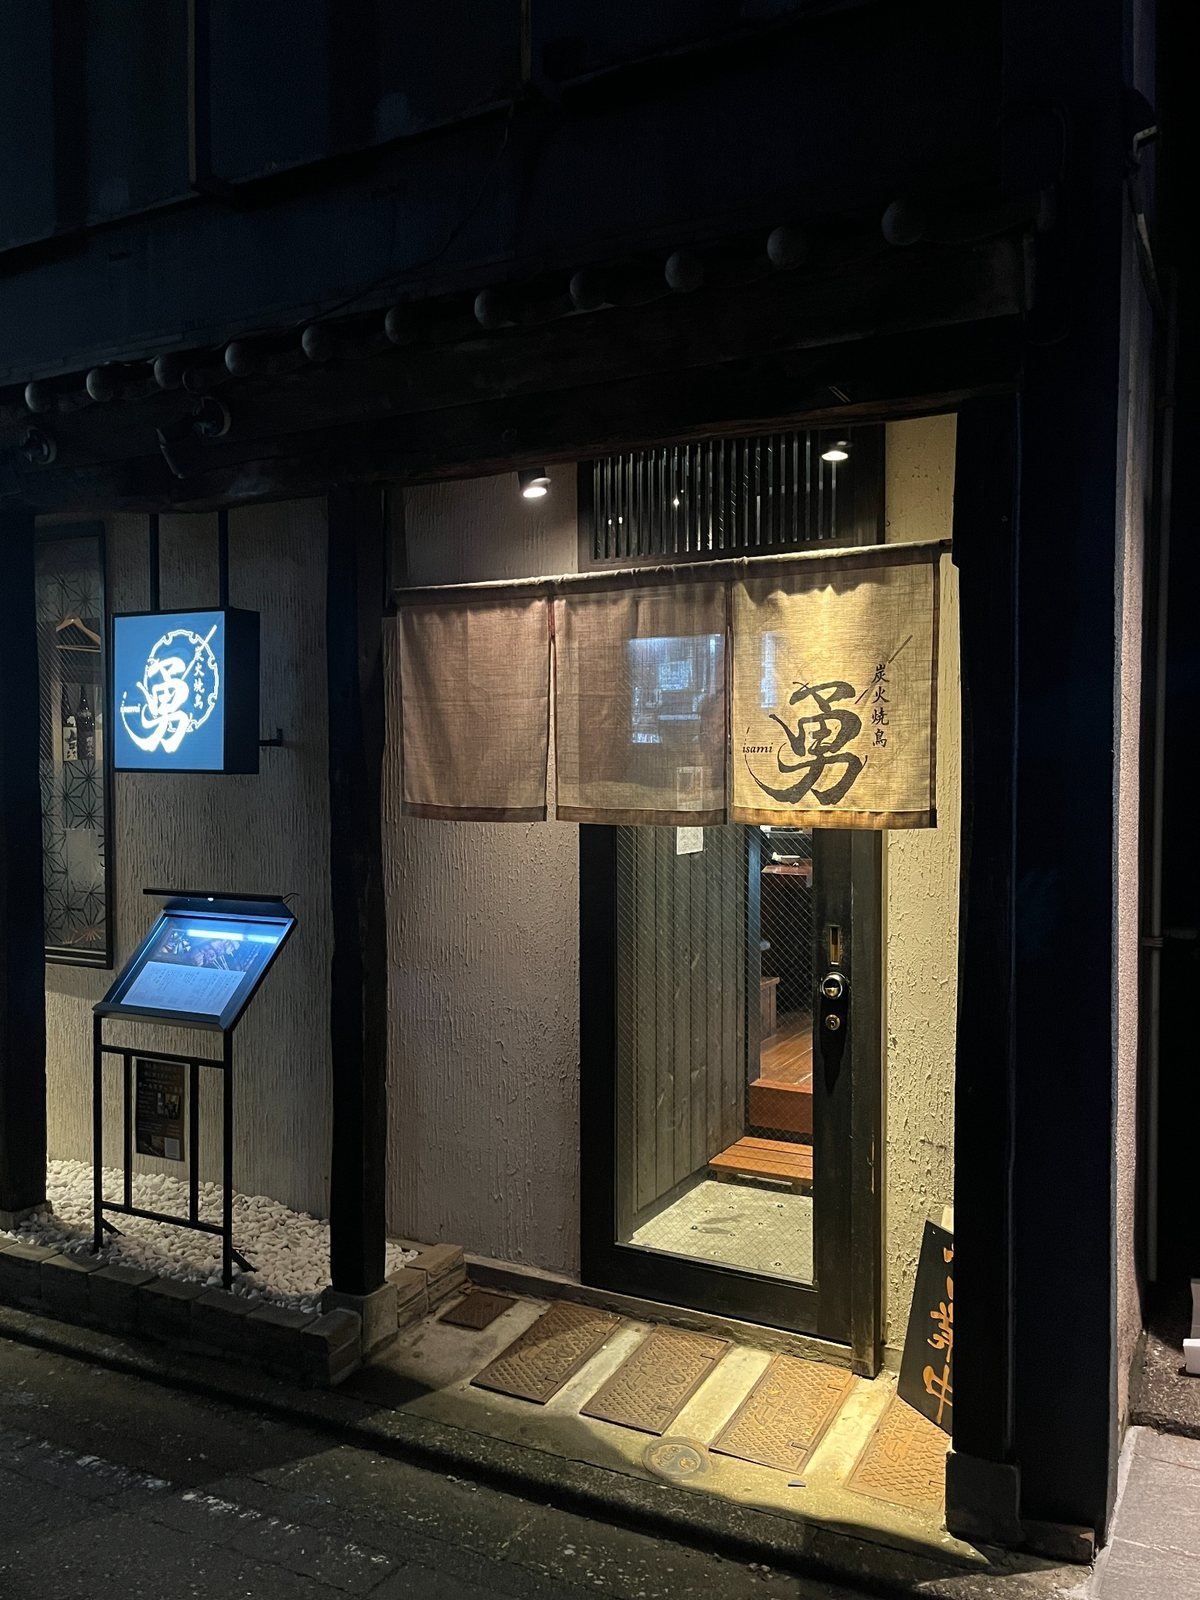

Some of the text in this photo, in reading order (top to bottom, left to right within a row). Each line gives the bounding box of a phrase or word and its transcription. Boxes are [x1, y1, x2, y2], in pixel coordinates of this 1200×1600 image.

[122, 656, 192, 753] 勇
[742, 742, 774, 754] isami
[745, 681, 868, 806] 勇
[870, 663, 891, 748] 炭火焼鳥
